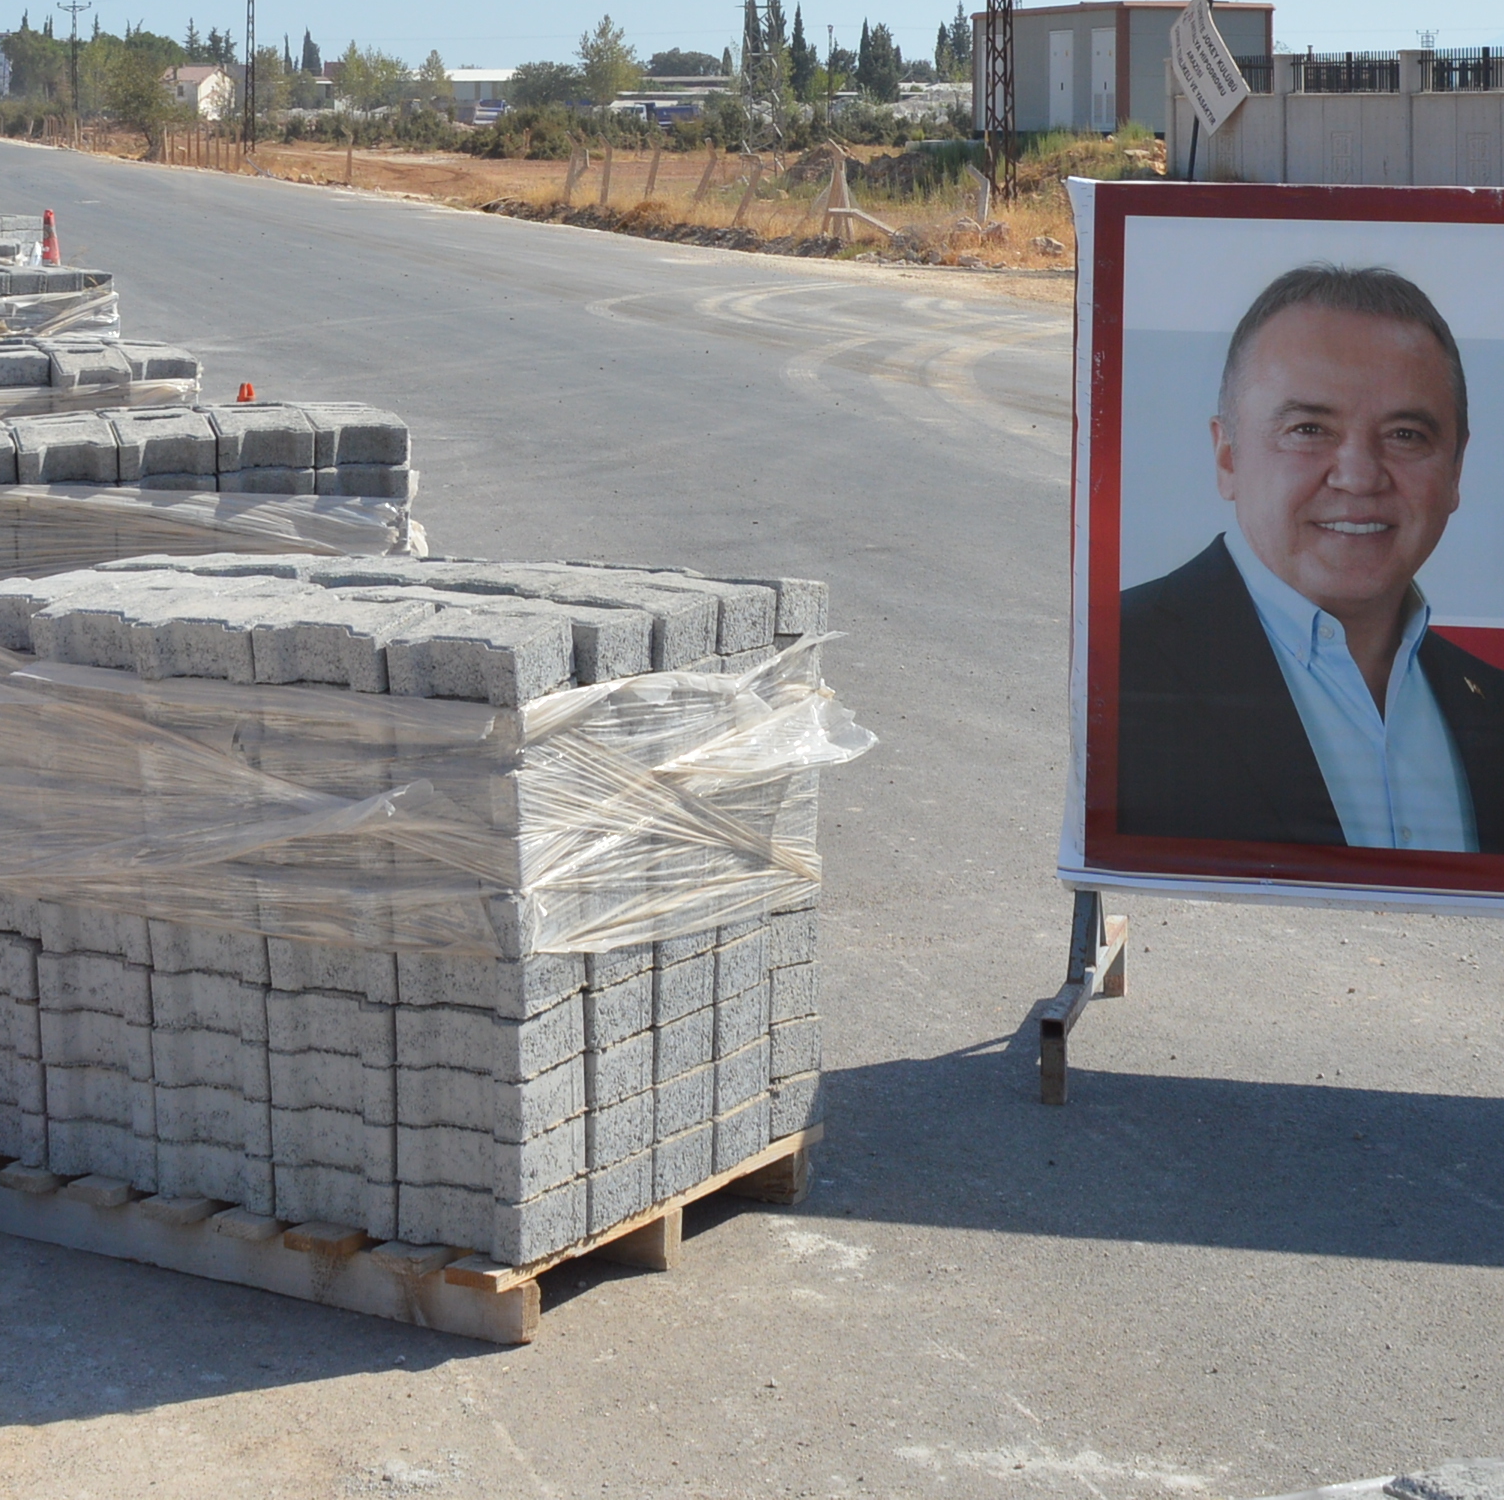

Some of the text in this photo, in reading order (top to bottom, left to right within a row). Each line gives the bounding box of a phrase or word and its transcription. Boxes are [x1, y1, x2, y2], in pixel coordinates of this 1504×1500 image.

[1199, 50, 1226, 96] HİPODROMU
[1202, 33, 1219, 59] JOKEY
[1216, 58, 1238, 93] KULÜBÜ
[1190, 80, 1198, 93] VE
[1196, 91, 1216, 126] YASAKTIR
